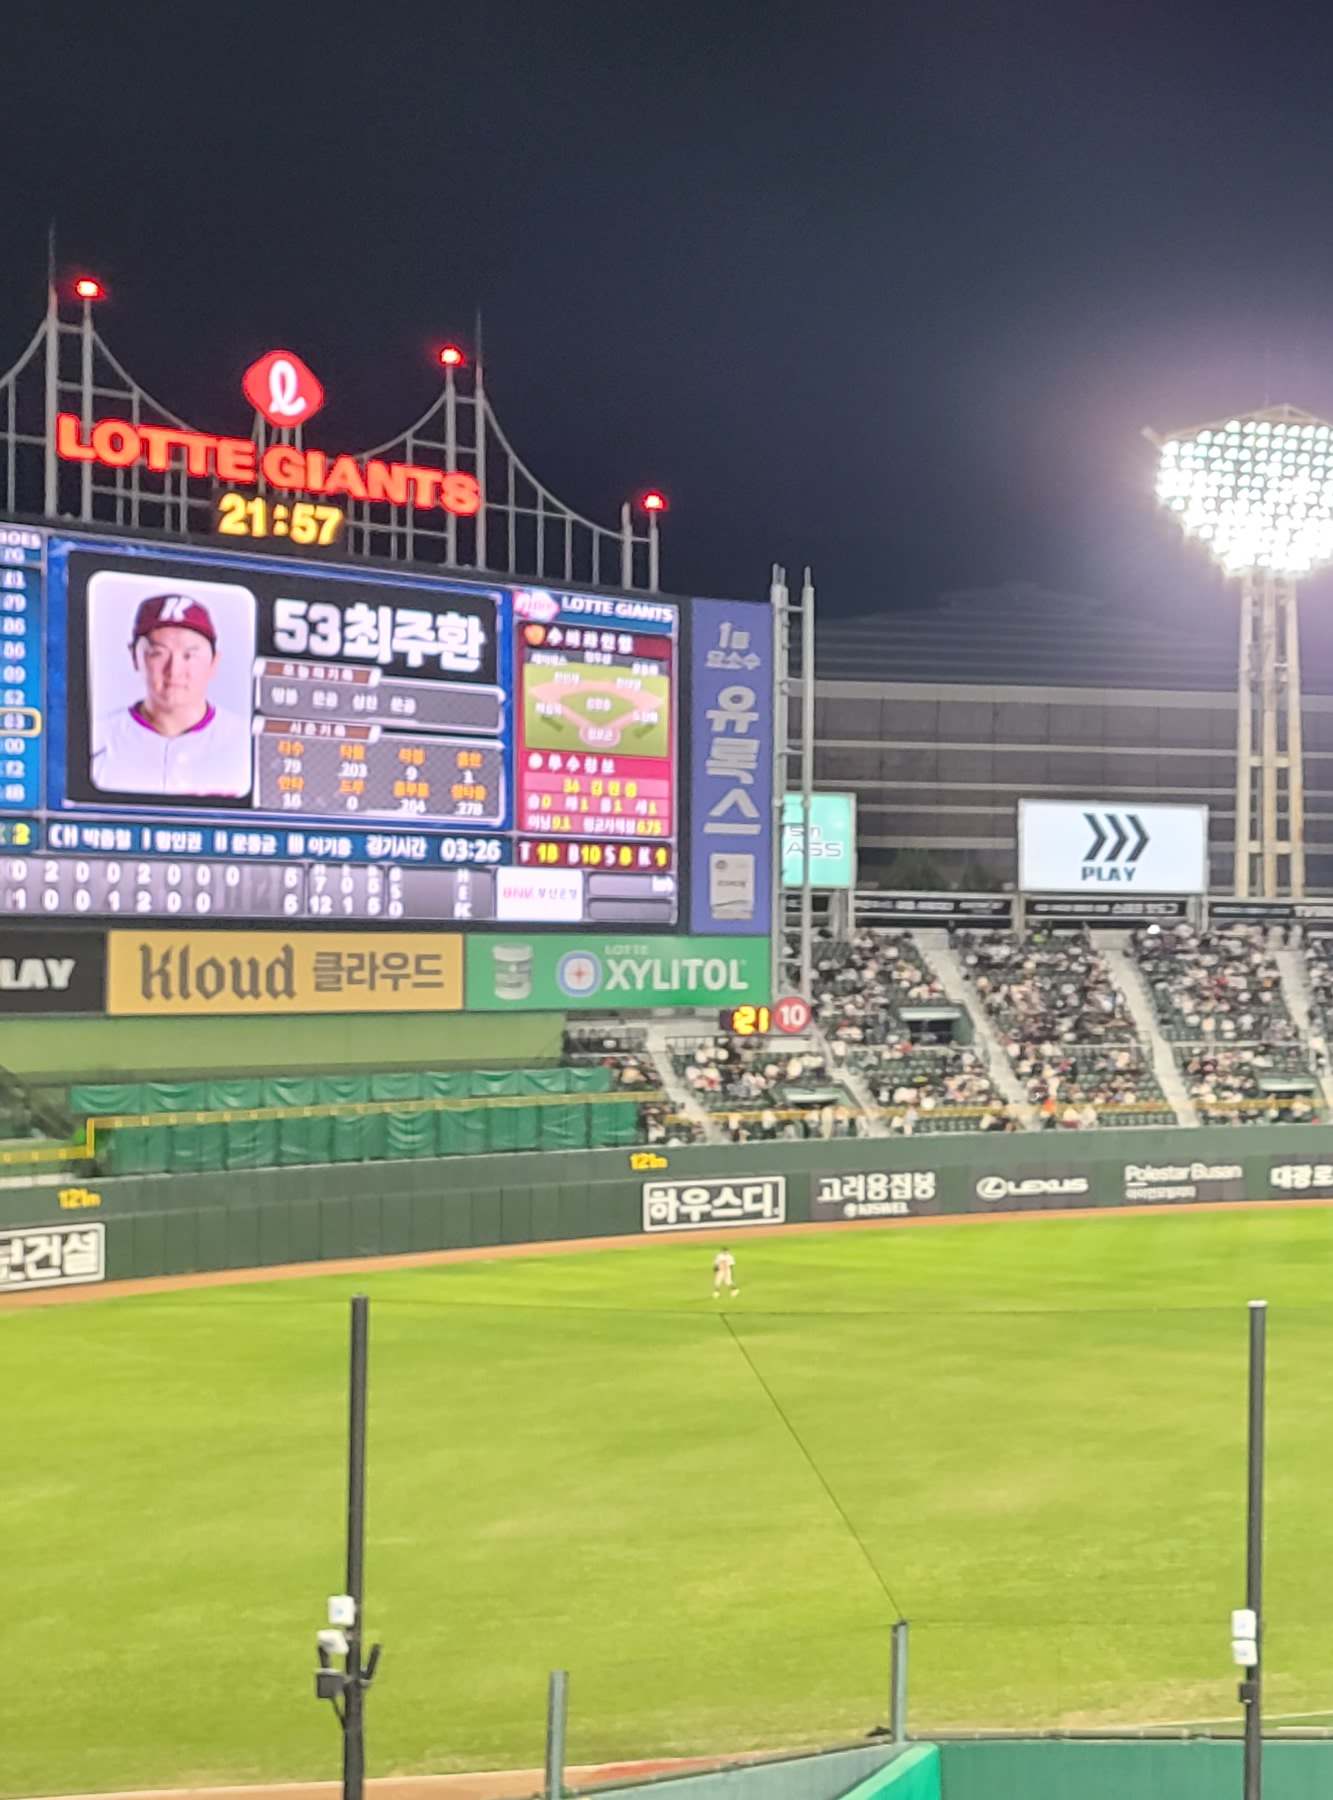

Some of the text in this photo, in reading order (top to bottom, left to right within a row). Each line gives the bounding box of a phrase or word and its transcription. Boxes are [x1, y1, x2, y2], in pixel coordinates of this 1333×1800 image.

[57, 413, 481, 515] LOTTE GIANTS
[218, 493, 344, 546] 21:57
[158, 597, 194, 622] K
[561, 597, 674, 622] LOTTE GIANTS
[284, 759, 301, 774] 79
[406, 767, 417, 781] 9
[703, 685, 762, 836] 유록스
[440, 838, 501, 862] 03:26
[519, 843, 530, 862] T
[580, 843, 601, 863] 10
[604, 845, 615, 864] S
[639, 847, 651, 866] K
[1081, 866, 1136, 881] PLAY
[140, 942, 445, 1001] Kloud 클라우드
[604, 958, 749, 991] XYLITOL
[780, 1005, 803, 1025] 10
[631, 1153, 668, 1170] 121m
[1125, 1163, 1243, 1182] Polestar Busan
[816, 1171, 936, 1202] 고려용접봉
[1008, 1177, 1089, 1194] LEXUS
[58, 1188, 101, 1209] 121m
